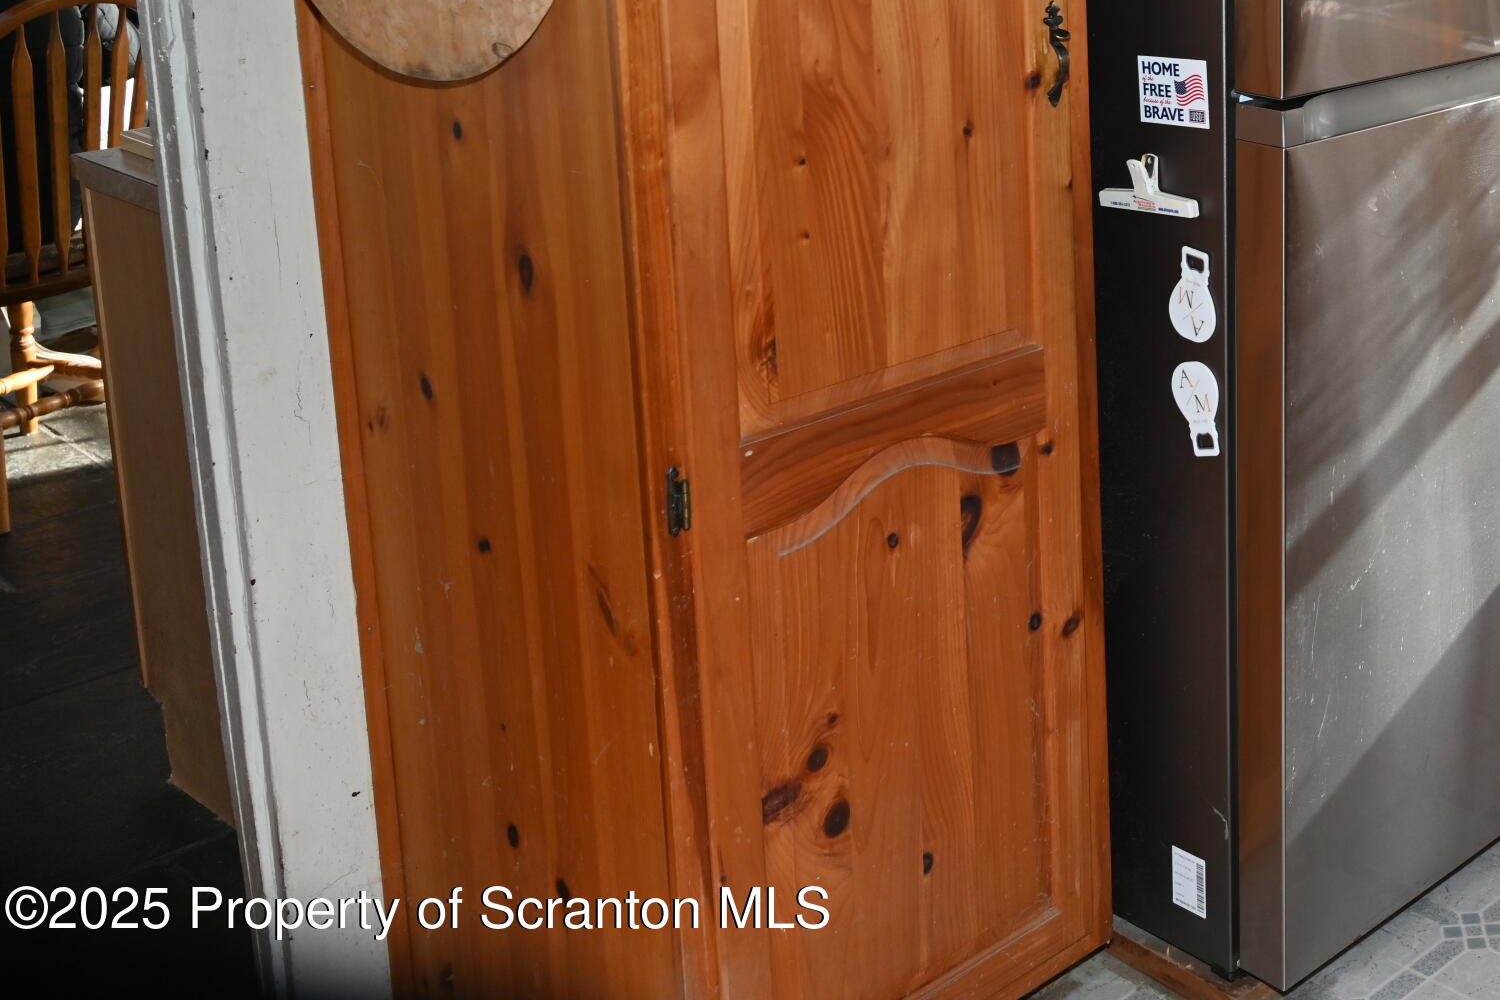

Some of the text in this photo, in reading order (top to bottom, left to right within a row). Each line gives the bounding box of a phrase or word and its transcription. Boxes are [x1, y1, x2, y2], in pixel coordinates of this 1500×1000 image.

[1142, 61, 1180, 77] HOME
[1143, 83, 1172, 98] FREE
[1144, 105, 1185, 122] BRAVE
[1180, 369, 1194, 388] A
[1195, 393, 1212, 413] M
